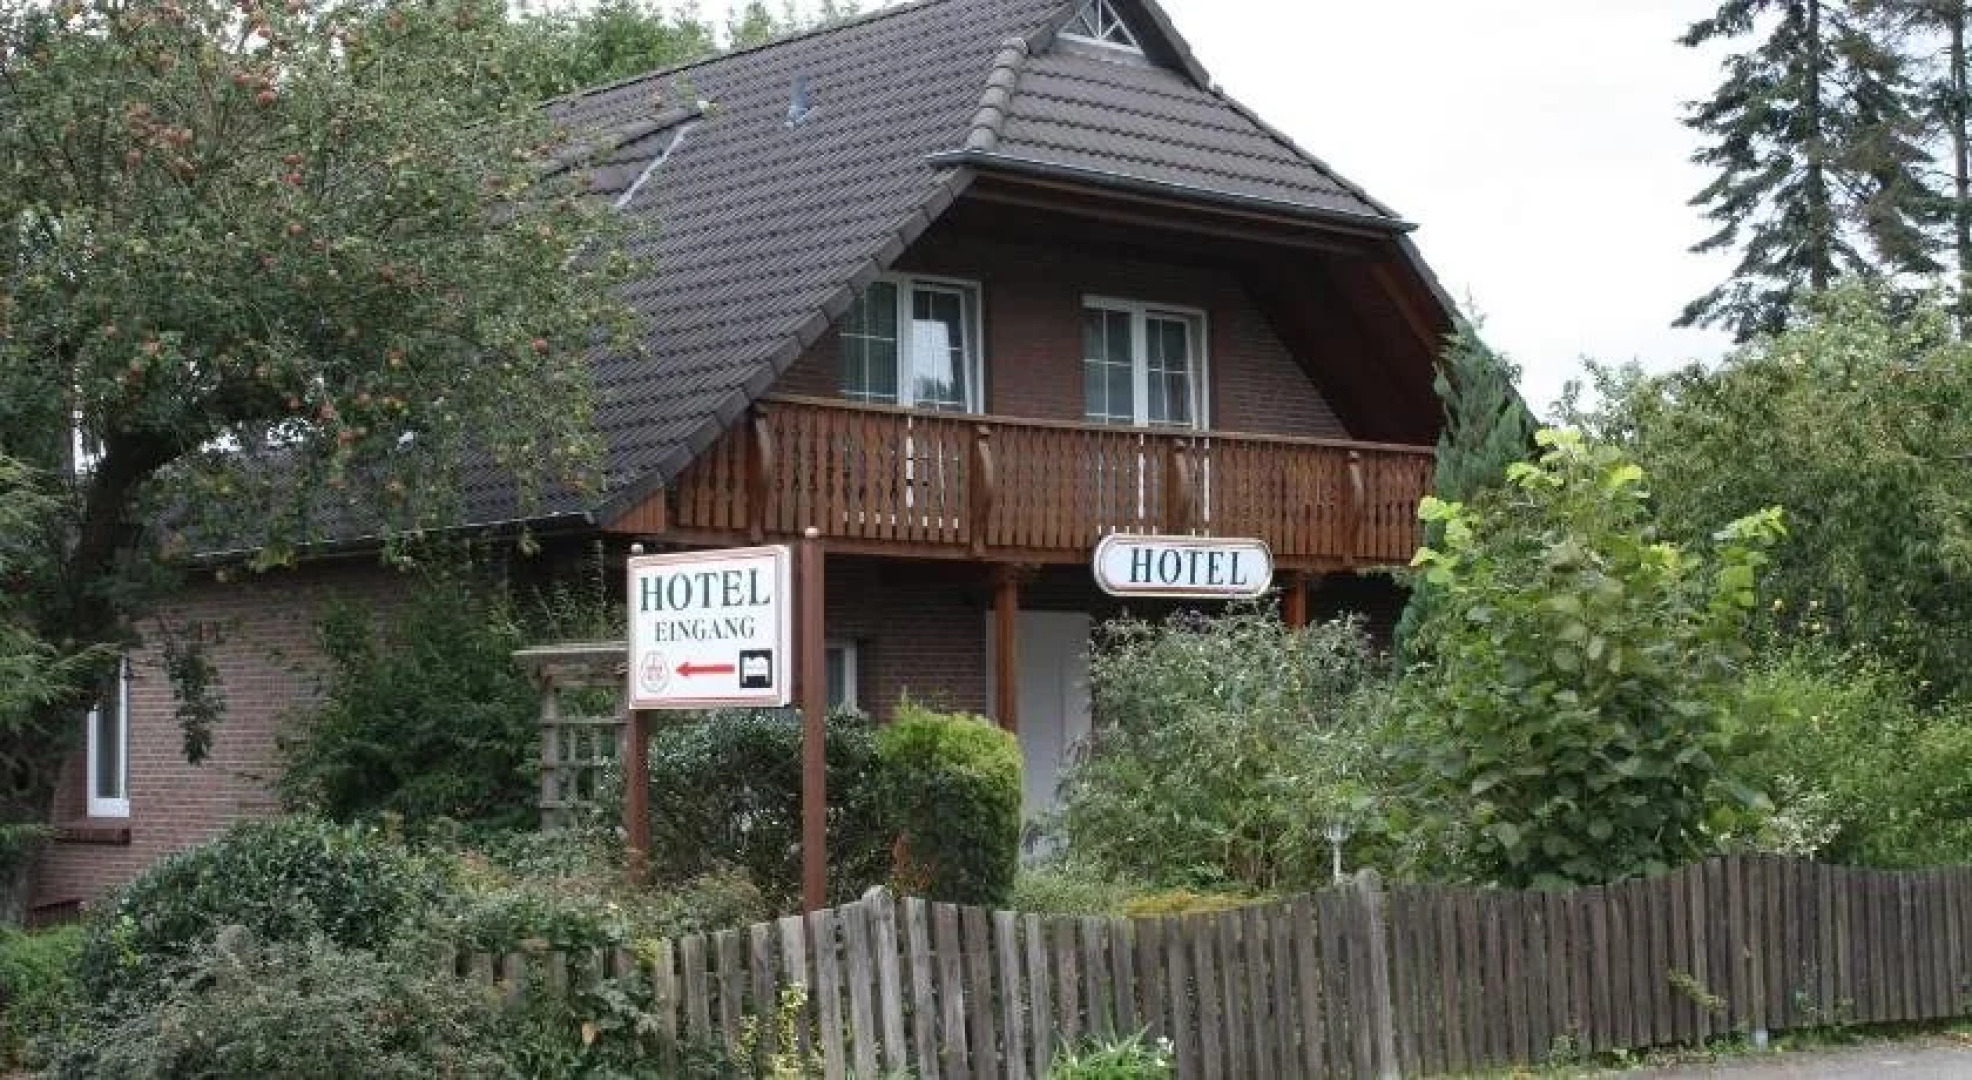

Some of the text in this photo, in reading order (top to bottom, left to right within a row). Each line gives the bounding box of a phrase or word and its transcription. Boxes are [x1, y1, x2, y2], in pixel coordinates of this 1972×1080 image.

[1129, 547, 1248, 585] HOTEL
[640, 568, 771, 612] HOTEL
[655, 616, 755, 642] EINGANG
